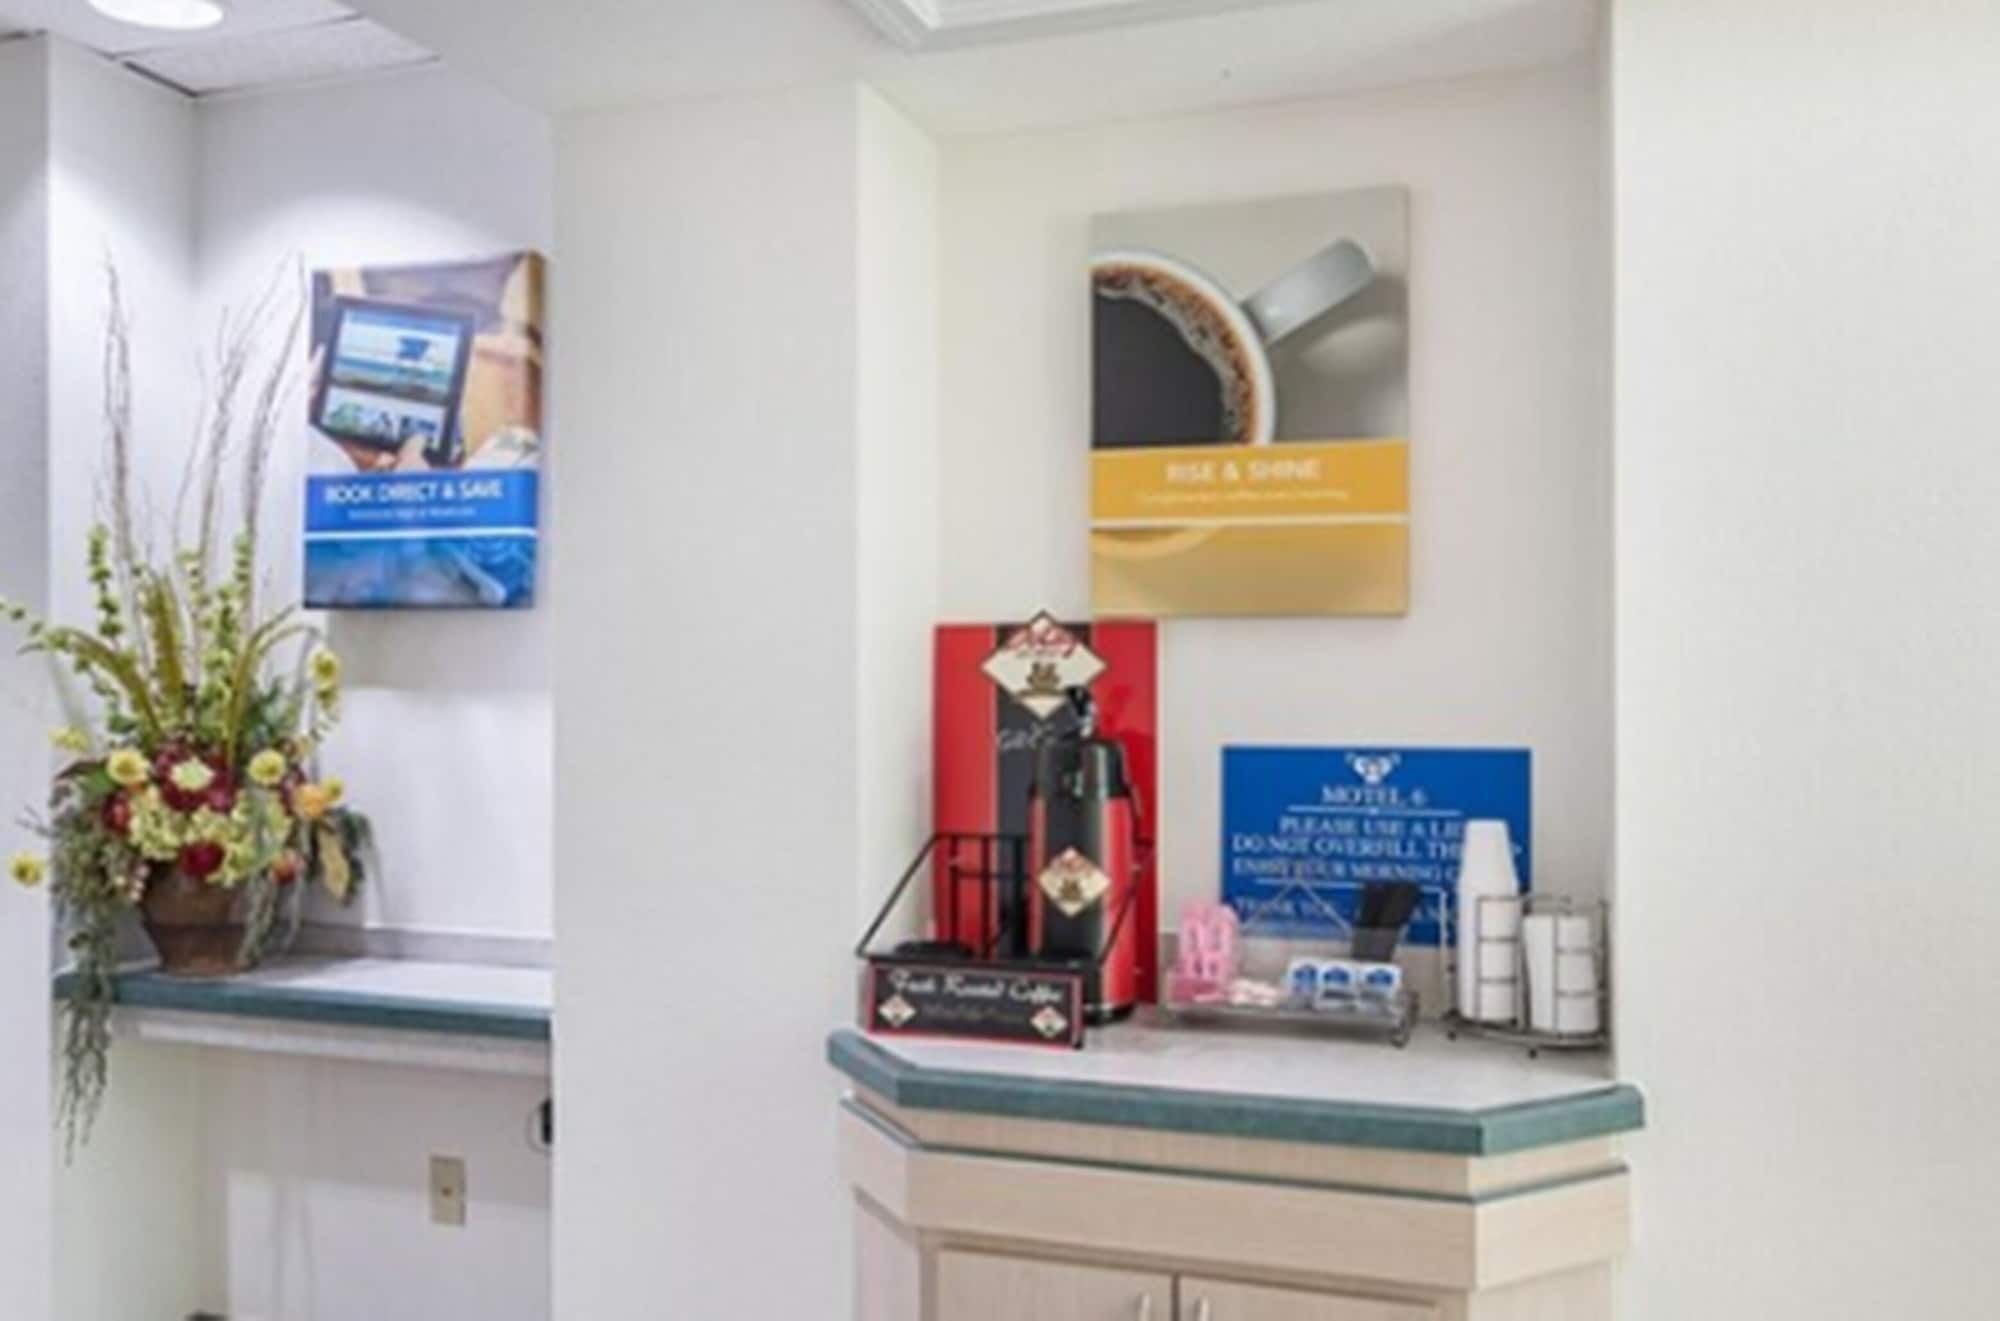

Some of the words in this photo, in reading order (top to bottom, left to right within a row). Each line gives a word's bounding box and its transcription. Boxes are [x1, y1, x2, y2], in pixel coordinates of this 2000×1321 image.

[1167, 461, 1214, 482] RISE
[1222, 460, 1239, 481] &
[325, 485, 372, 504] BOOK
[378, 481, 438, 502] DIRECT
[442, 481, 455, 499] &
[459, 478, 504, 499] SAVE
[1321, 785, 1399, 806] MOTEL
[1411, 788, 1428, 807] 6
[1280, 816, 1358, 836] PLEASE
[1362, 818, 1406, 837] USE
[1410, 820, 1426, 837] A
[1232, 834, 1265, 854] DO
[1268, 836, 1310, 855] NOT
[1314, 837, 1422, 859] OVERFILL
[1351, 863, 1440, 884] MORNING
